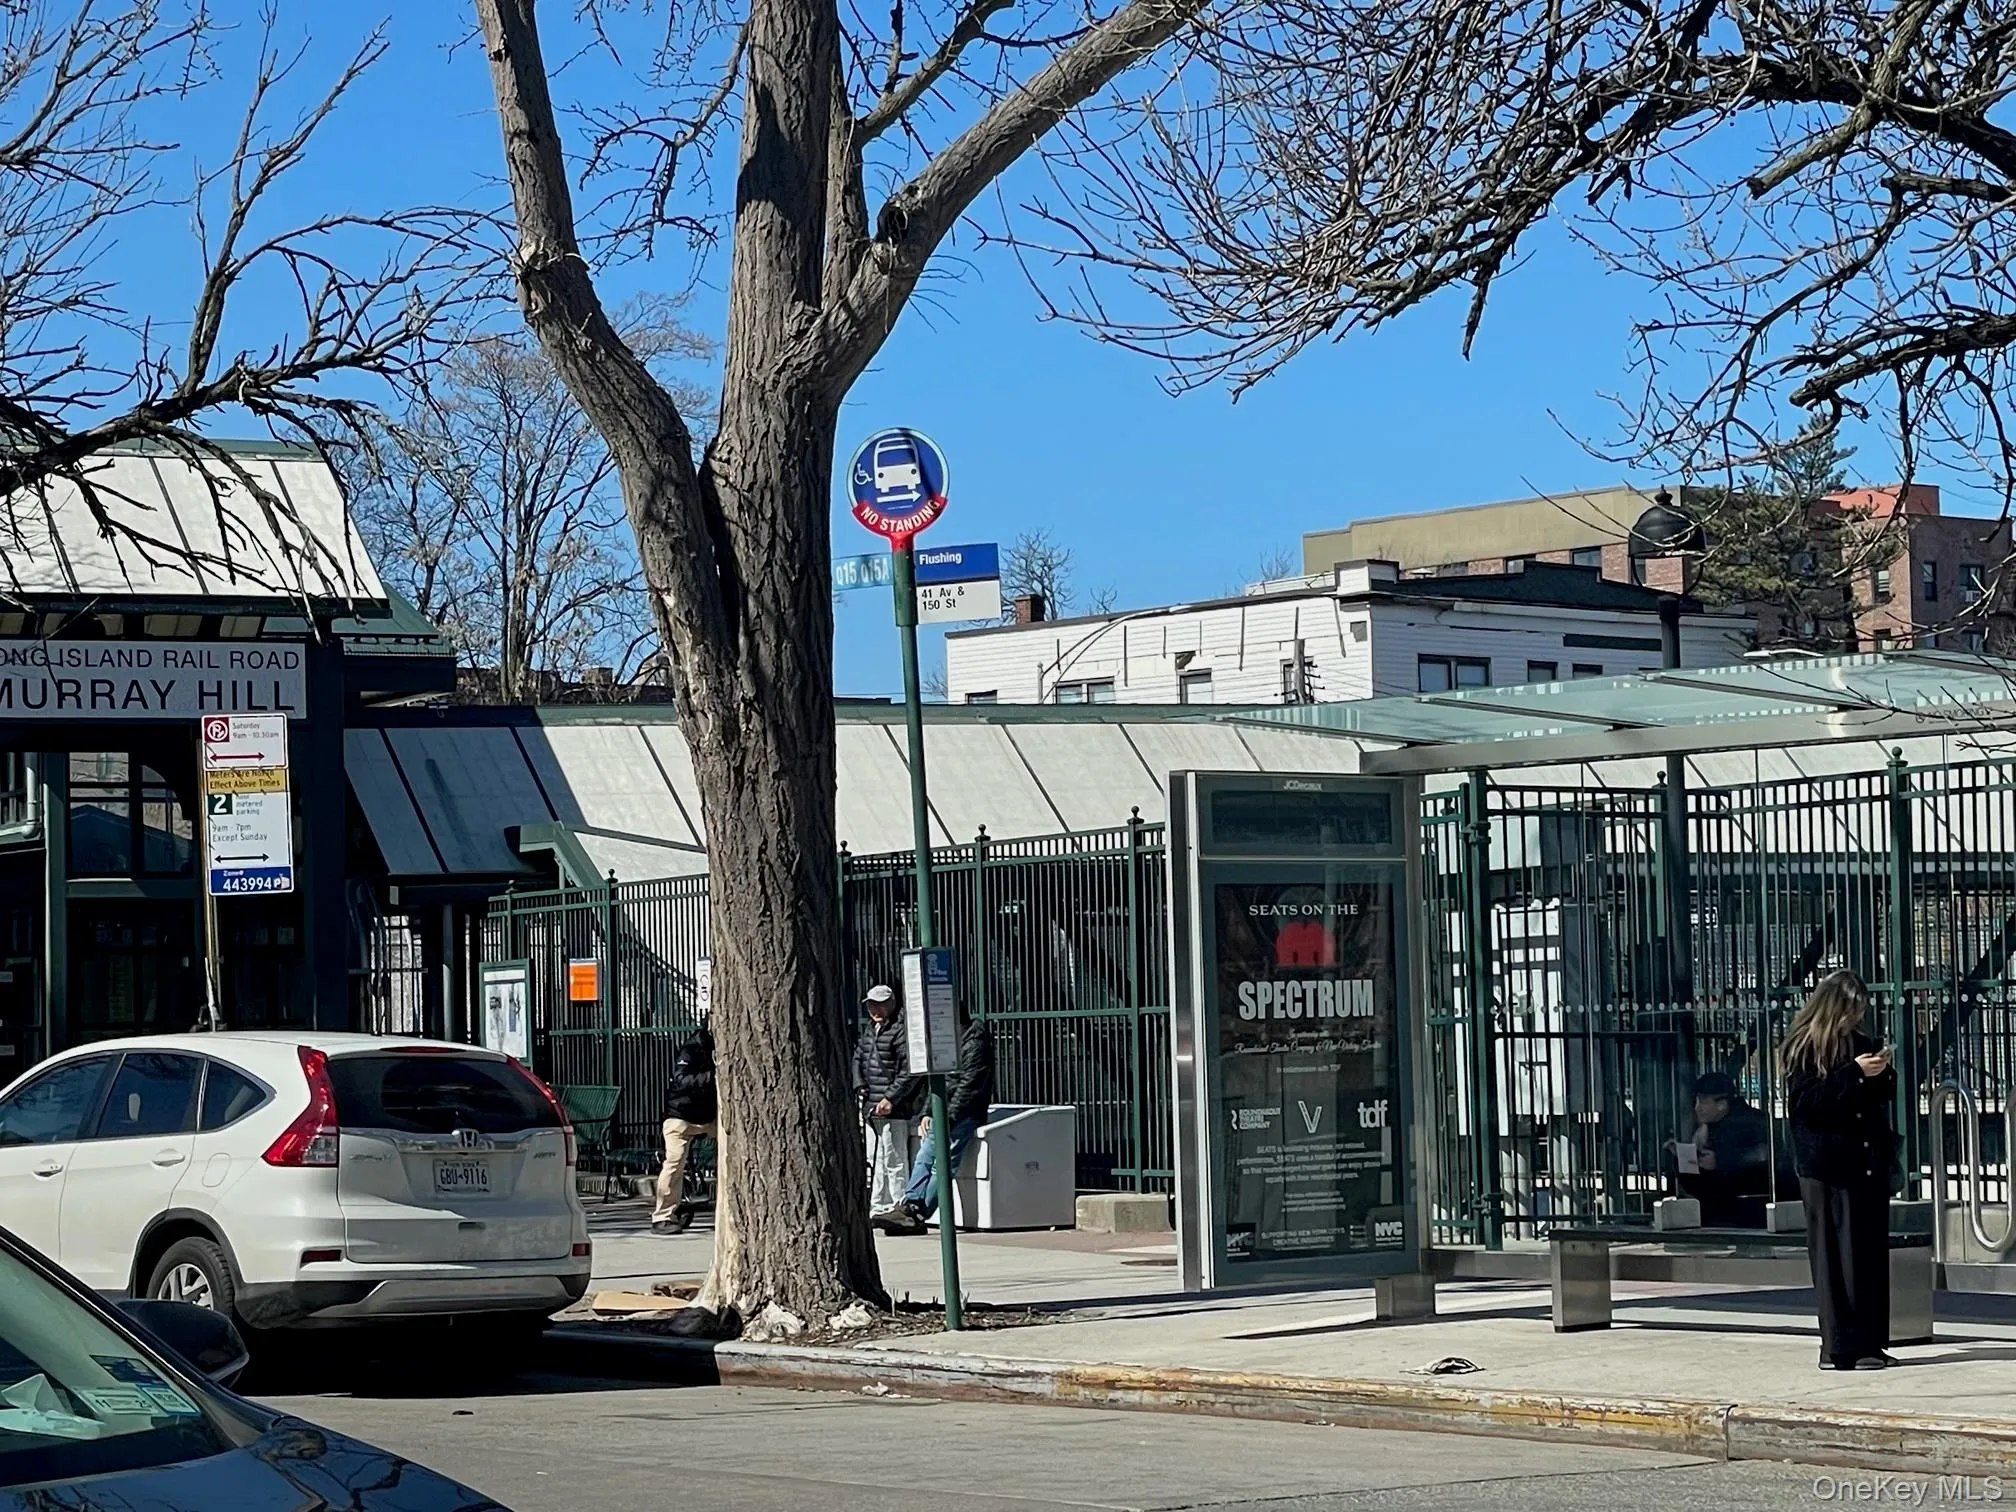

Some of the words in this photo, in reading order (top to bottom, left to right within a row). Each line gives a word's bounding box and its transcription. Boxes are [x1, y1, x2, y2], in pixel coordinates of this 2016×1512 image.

[861, 506, 879, 526] NO
[880, 499, 941, 532] STANDING
[919, 552, 962, 565] Flushing
[921, 589, 932, 599] 41
[939, 587, 952, 597] Av
[957, 586, 965, 597] &
[922, 600, 940, 611] 150
[946, 598, 957, 609] St
[60, 648, 152, 668] ISLAND
[163, 650, 220, 669] RAIL
[229, 651, 299, 669] ROAD
[198, 680, 295, 711] HILL
[210, 781, 232, 789] Effect
[233, 780, 256, 788] Above
[259, 778, 280, 787] Times
[213, 794, 227, 813] 2
[212, 824, 228, 832] 9am
[212, 834, 237, 842] Except
[240, 832, 268, 840] Sunday
[223, 877, 272, 891] 443994
[1248, 904, 1298, 916] SEATS
[1301, 904, 1323, 916] ON
[1328, 904, 1359, 915] THE
[1238, 979, 1375, 1020] SPECTRUM
[1357, 1099, 1389, 1128] tdf
[1374, 1222, 1403, 1237] NYC
